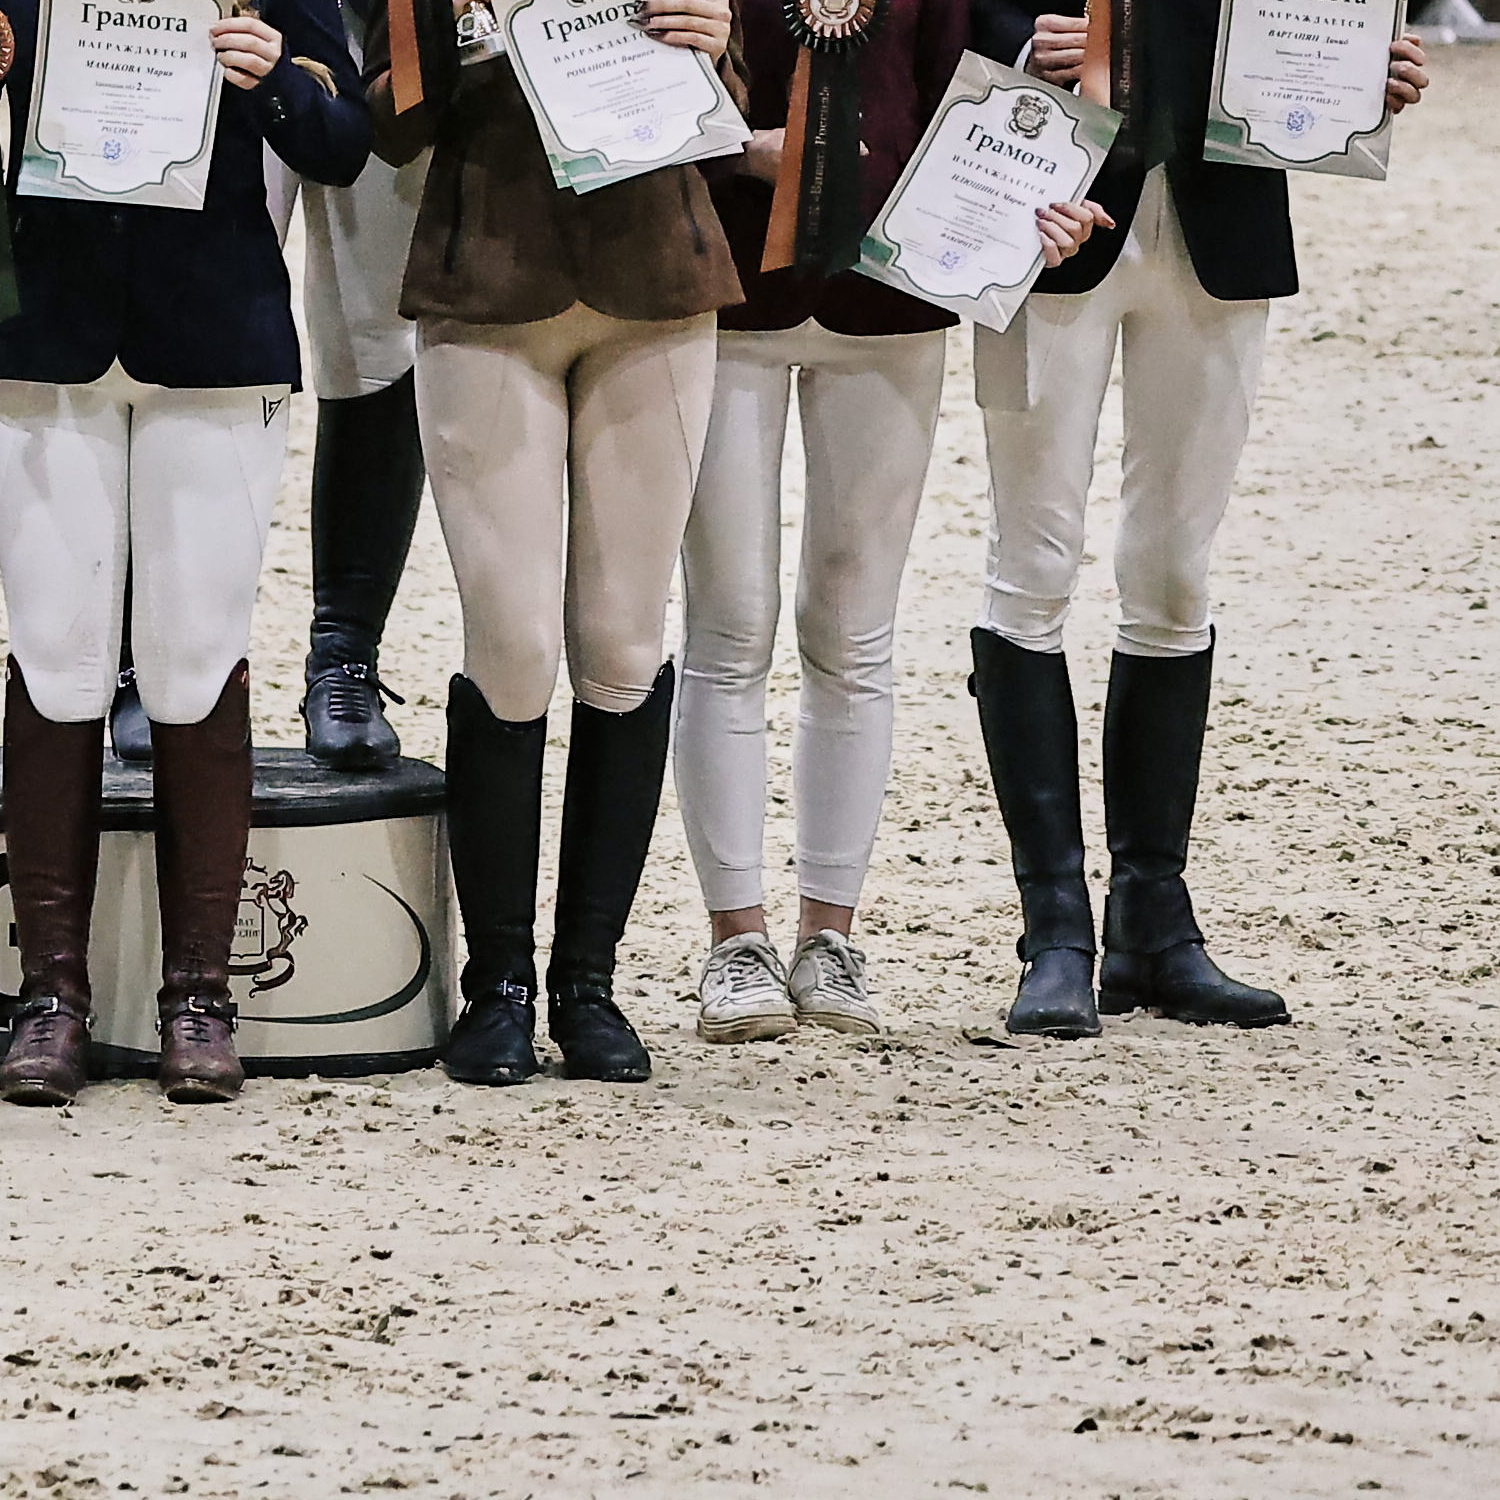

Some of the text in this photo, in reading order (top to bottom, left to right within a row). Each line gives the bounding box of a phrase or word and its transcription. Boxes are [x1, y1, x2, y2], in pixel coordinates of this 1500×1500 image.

[81, 2, 188, 33] Грамота
[541, 2, 641, 42] Грамот
[1258, 9, 1365, 29] НАГРАЖДАЕТСЯ
[1268, 29, 1320, 43] ВАРТАНЯН
[78, 39, 188, 59] НАГРАЖДАЕТСЯ
[85, 60, 174, 77] МАМАКОВА Мария
[566, 58, 618, 79] РОМАНОВА
[964, 122, 1058, 176] Грамота
[951, 173, 1000, 198] ИЛЮШИНА
[952, 153, 1046, 196] НАГРАЖДАЕТСЯ
